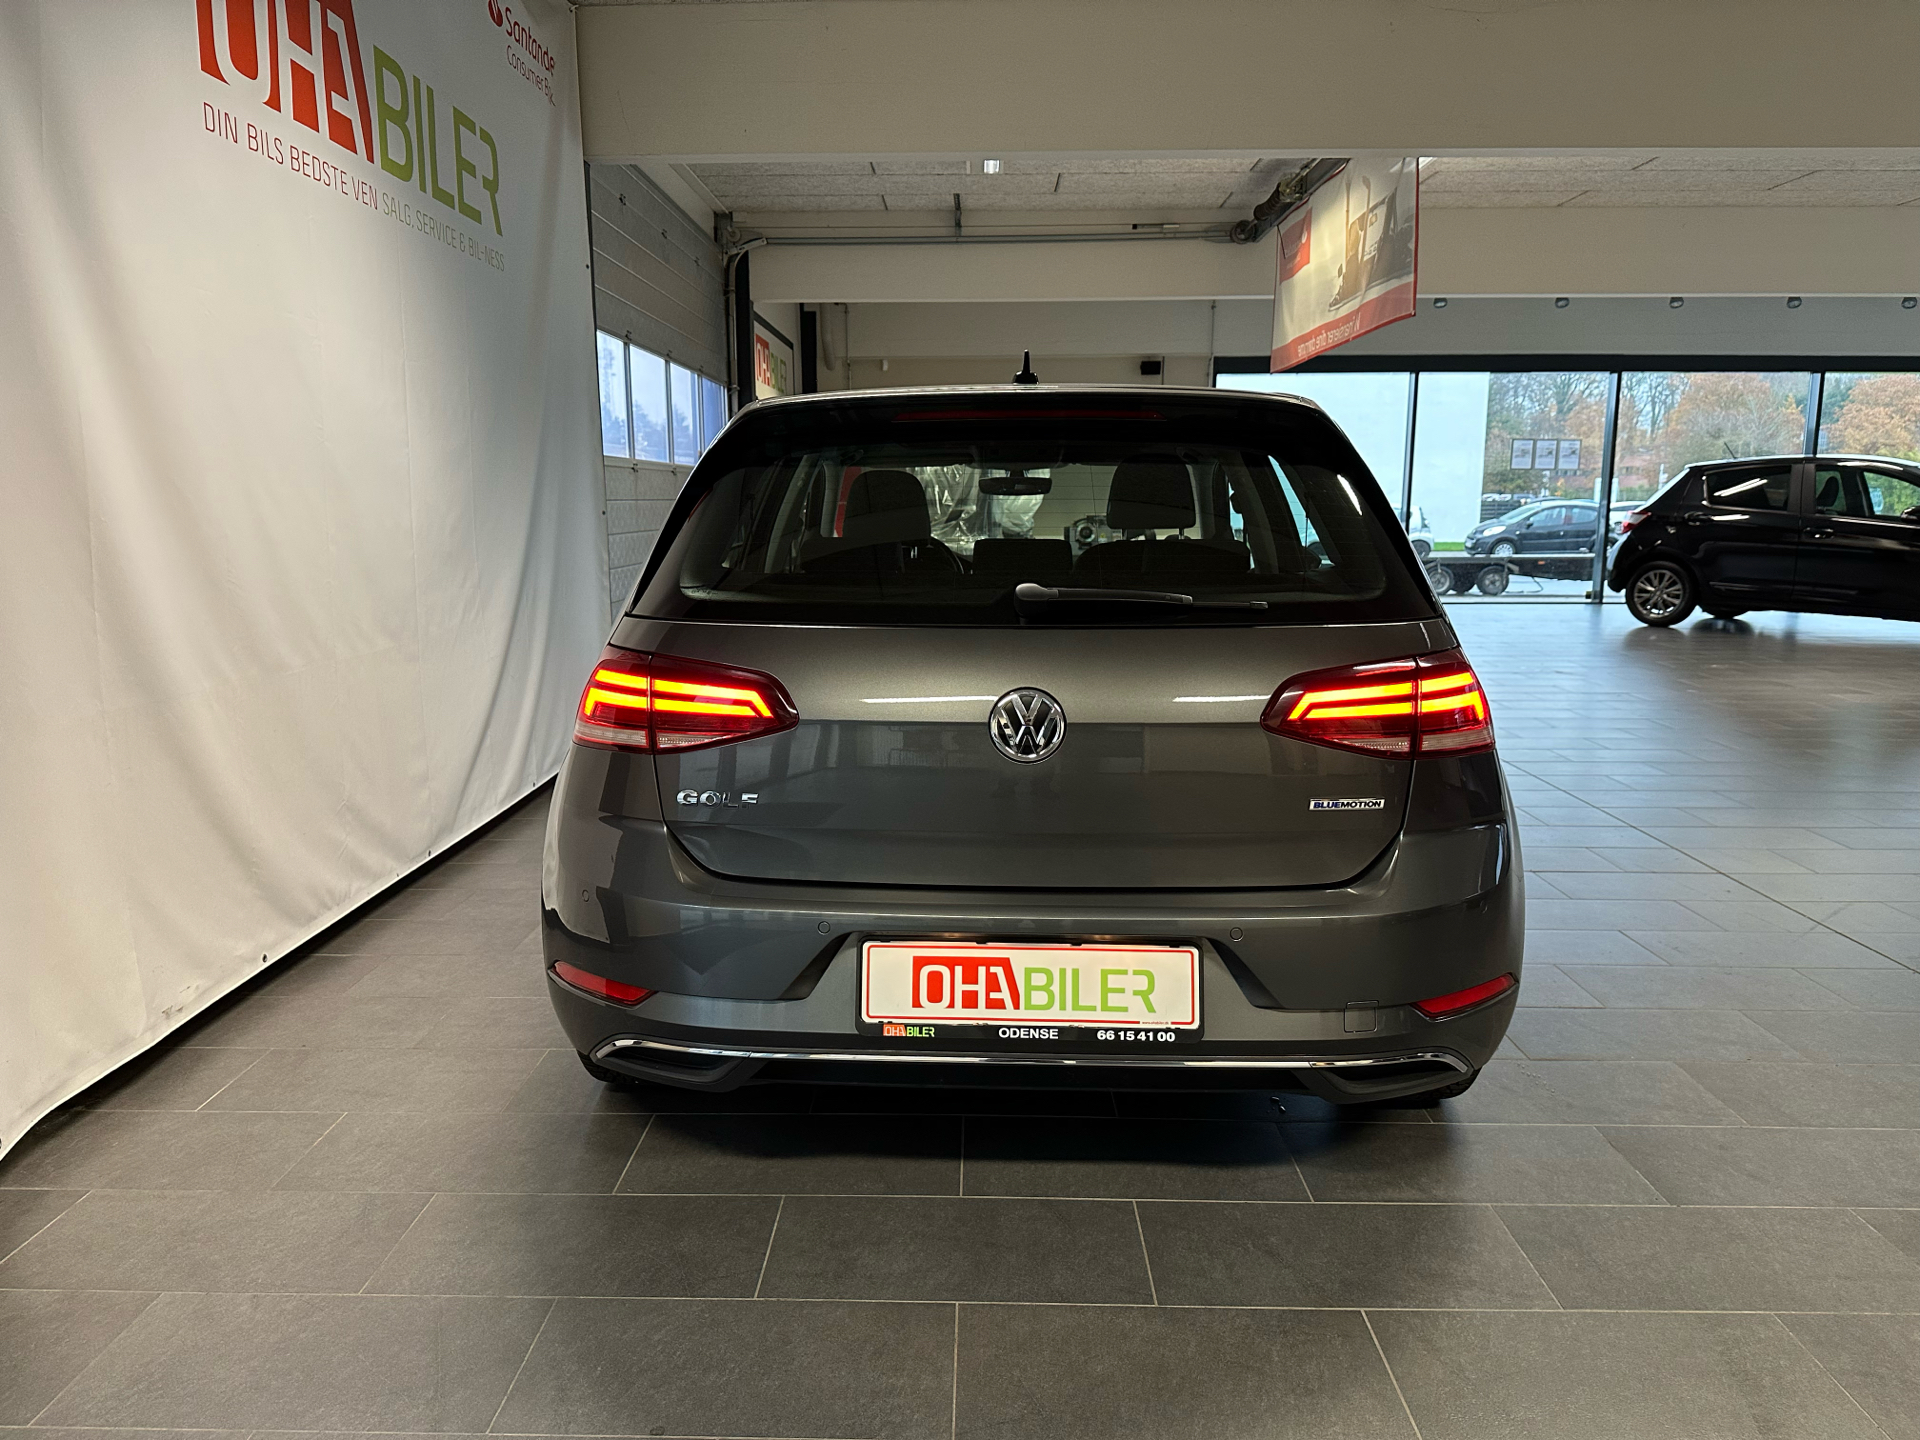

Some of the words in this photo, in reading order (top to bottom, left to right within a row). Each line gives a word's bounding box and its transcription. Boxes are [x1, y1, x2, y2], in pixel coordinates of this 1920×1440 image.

[507, 45, 544, 92] Consumer
[373, 44, 503, 236] BILER
[203, 101, 238, 144] DIN
[247, 122, 284, 165] BILS
[289, 144, 348, 195] BEDSTE
[351, 175, 378, 211] VEN
[416, 209, 457, 249] SERVICE
[459, 231, 466, 253] &
[468, 236, 505, 272] BIL-NESS
[677, 789, 759, 808] GOLF
[1313, 800, 1382, 809] BLUEMOTION
[1024, 967, 1156, 1014] BILER
[998, 1027, 1059, 1040] ODENSE
